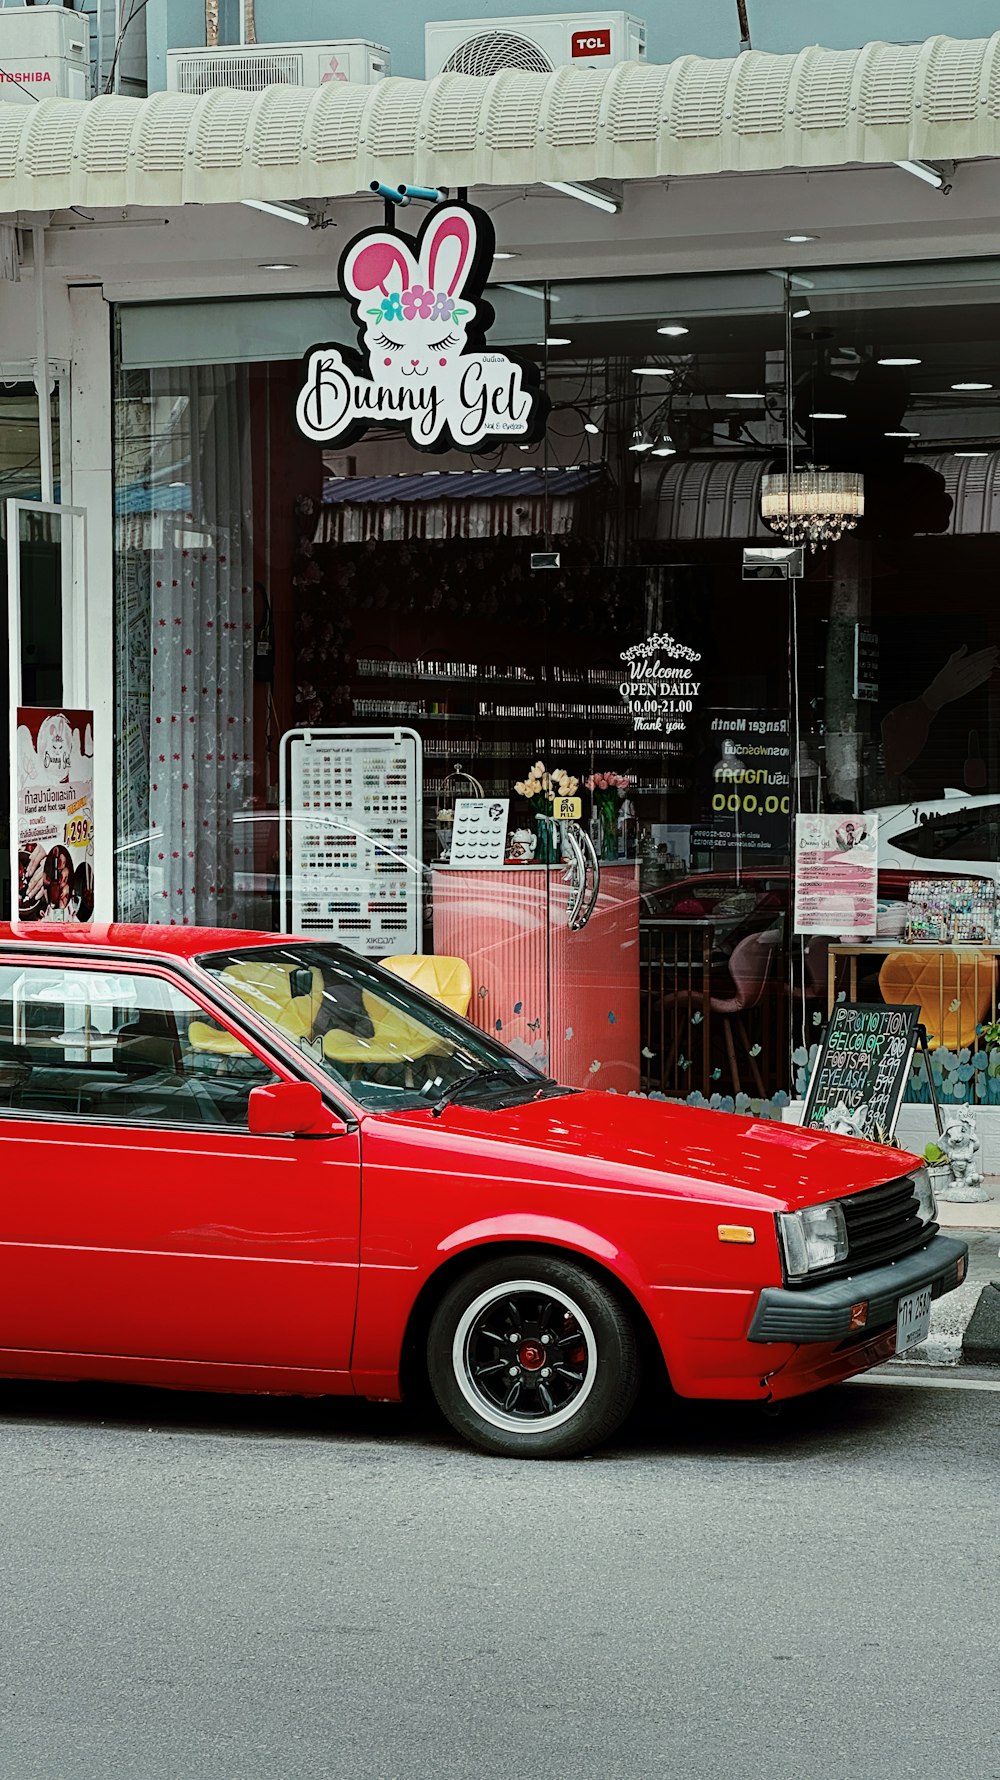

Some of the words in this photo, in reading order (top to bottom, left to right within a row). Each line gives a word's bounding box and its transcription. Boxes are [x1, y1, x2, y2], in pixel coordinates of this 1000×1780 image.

[576, 38, 606, 50] TCL
[0, 72, 51, 82] TOSHIBA
[304, 358, 445, 436] Bunny
[460, 362, 527, 436] Gel
[627, 659, 693, 679] Welcome
[619, 682, 658, 696] OPEN
[660, 682, 701, 696] DAILY
[628, 699, 693, 713] 10.00-21.00
[633, 717, 663, 731] Thank
[665, 722, 686, 735] you
[24, 805, 37, 814] Hand
[38, 804, 46, 812] and
[47, 803, 57, 811] foot
[58, 803, 66, 811] spa
[833, 1008, 912, 1036] PROMOTION
[884, 1036, 907, 1058] 200
[878, 1057, 901, 1076] 499
[820, 1068, 868, 1088] EYELASH
[873, 1074, 895, 1094] 599
[816, 1087, 864, 1107] LIFTING
[869, 1093, 890, 1112] 499
